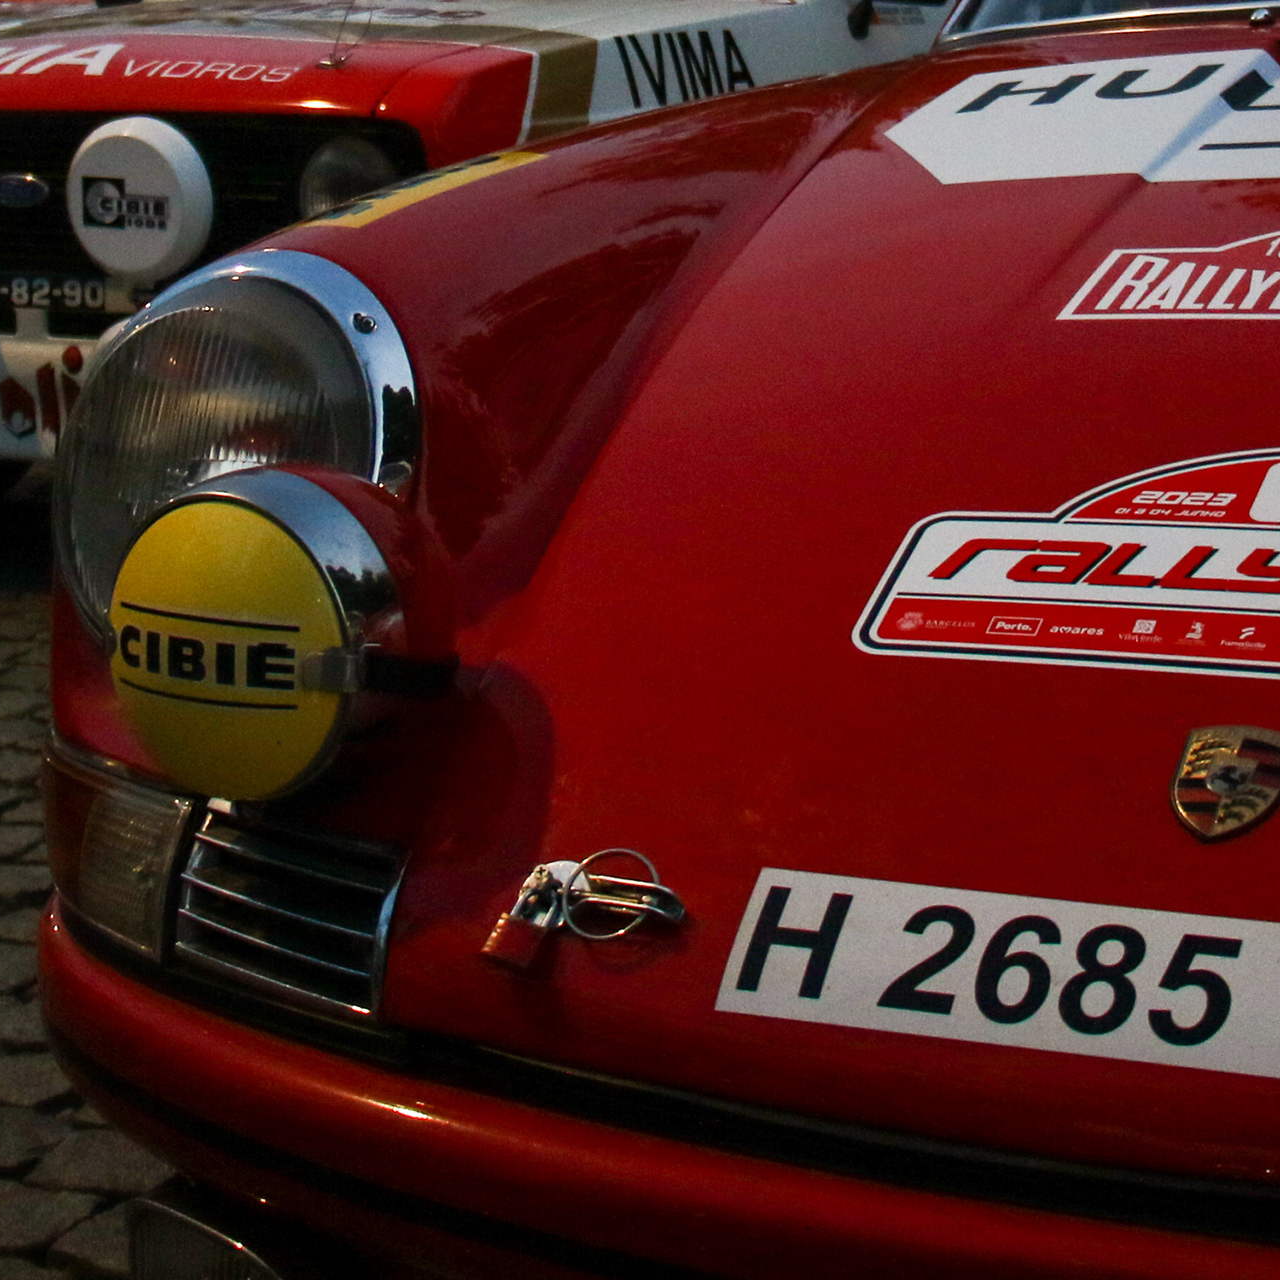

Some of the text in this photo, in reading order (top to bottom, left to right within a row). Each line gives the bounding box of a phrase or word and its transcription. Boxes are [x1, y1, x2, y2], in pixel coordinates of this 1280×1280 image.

[123, 58, 298, 83] VIDROS
[612, 28, 755, 109] IVIMA
[1131, 489, 1238, 507] 2023
[1174, 508, 1227, 518] JUNHO
[1049, 624, 1105, 636] amares
[734, 885, 854, 1000] H
[876, 903, 1243, 1048] 2685
